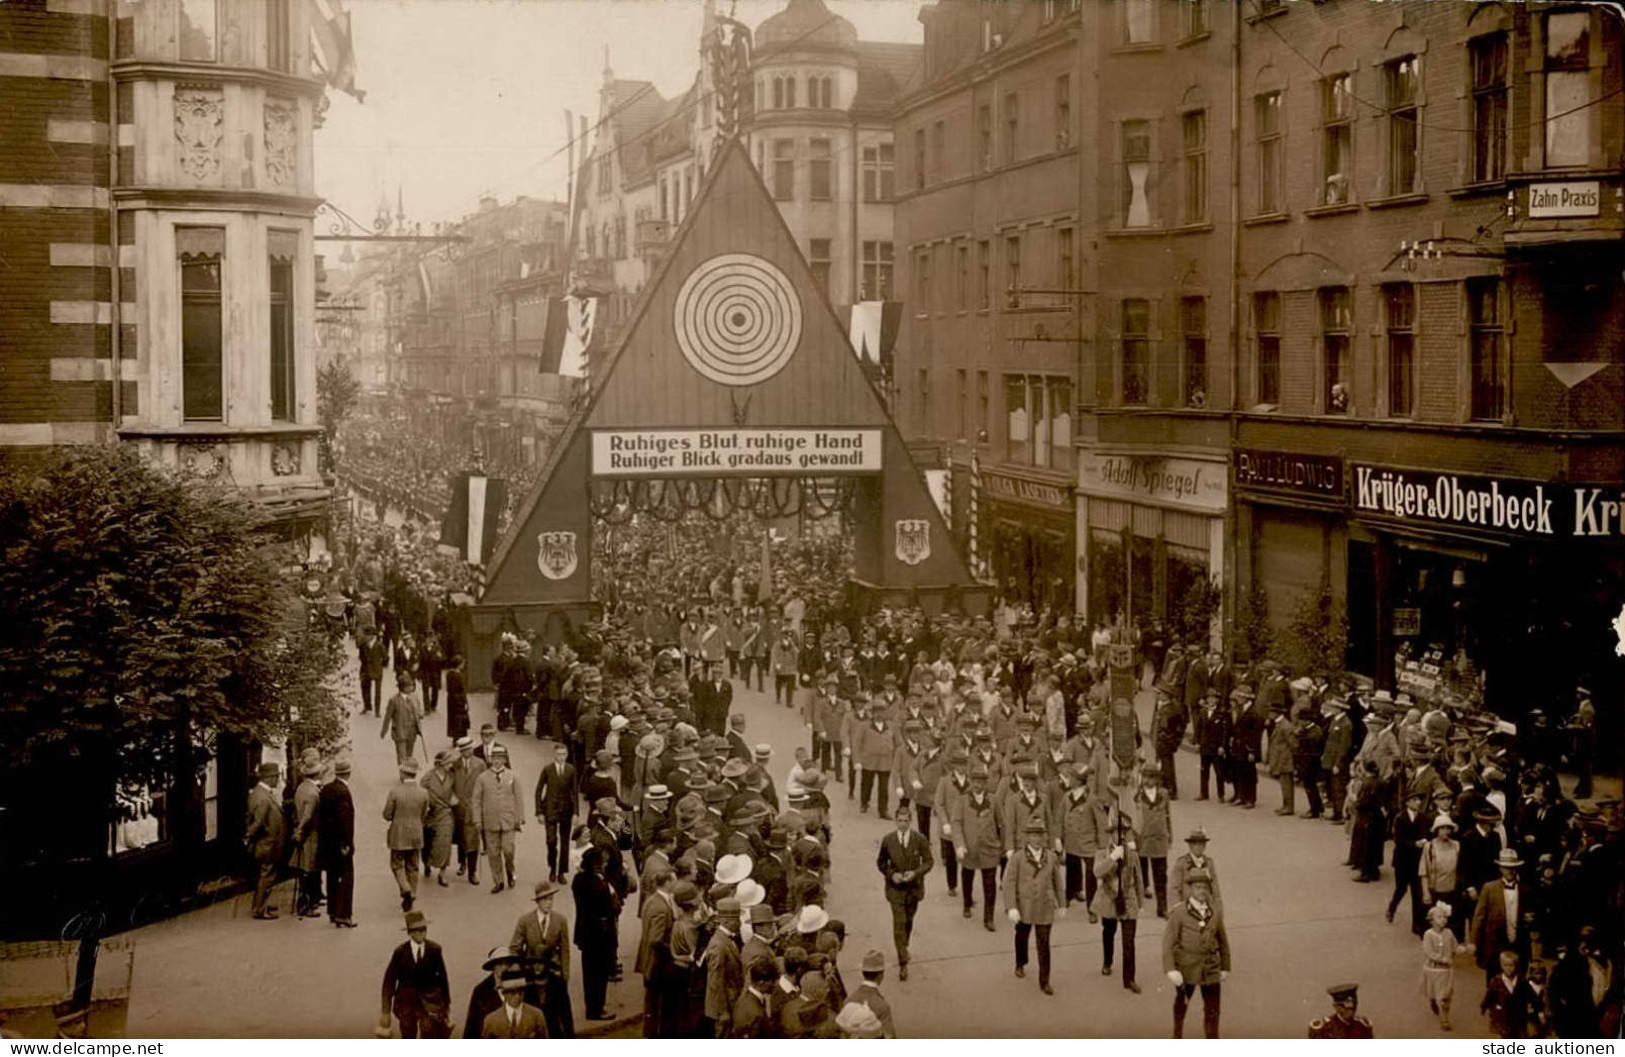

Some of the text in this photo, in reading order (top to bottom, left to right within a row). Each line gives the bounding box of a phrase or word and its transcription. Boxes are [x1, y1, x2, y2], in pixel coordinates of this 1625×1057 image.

[1531, 187, 1597, 208] Zahn Praxis
[610, 435, 691, 453] Ruhiges
[746, 433, 806, 451] ruhige
[815, 433, 863, 448] Hand
[611, 450, 863, 470] Ruhiger Blick gradaus gewandt
[1238, 453, 1335, 490] PAUL LUDWIG
[1101, 458, 1141, 490] Adolf
[1142, 459, 1202, 499] Spiegel
[1572, 487, 1625, 536] Kr
